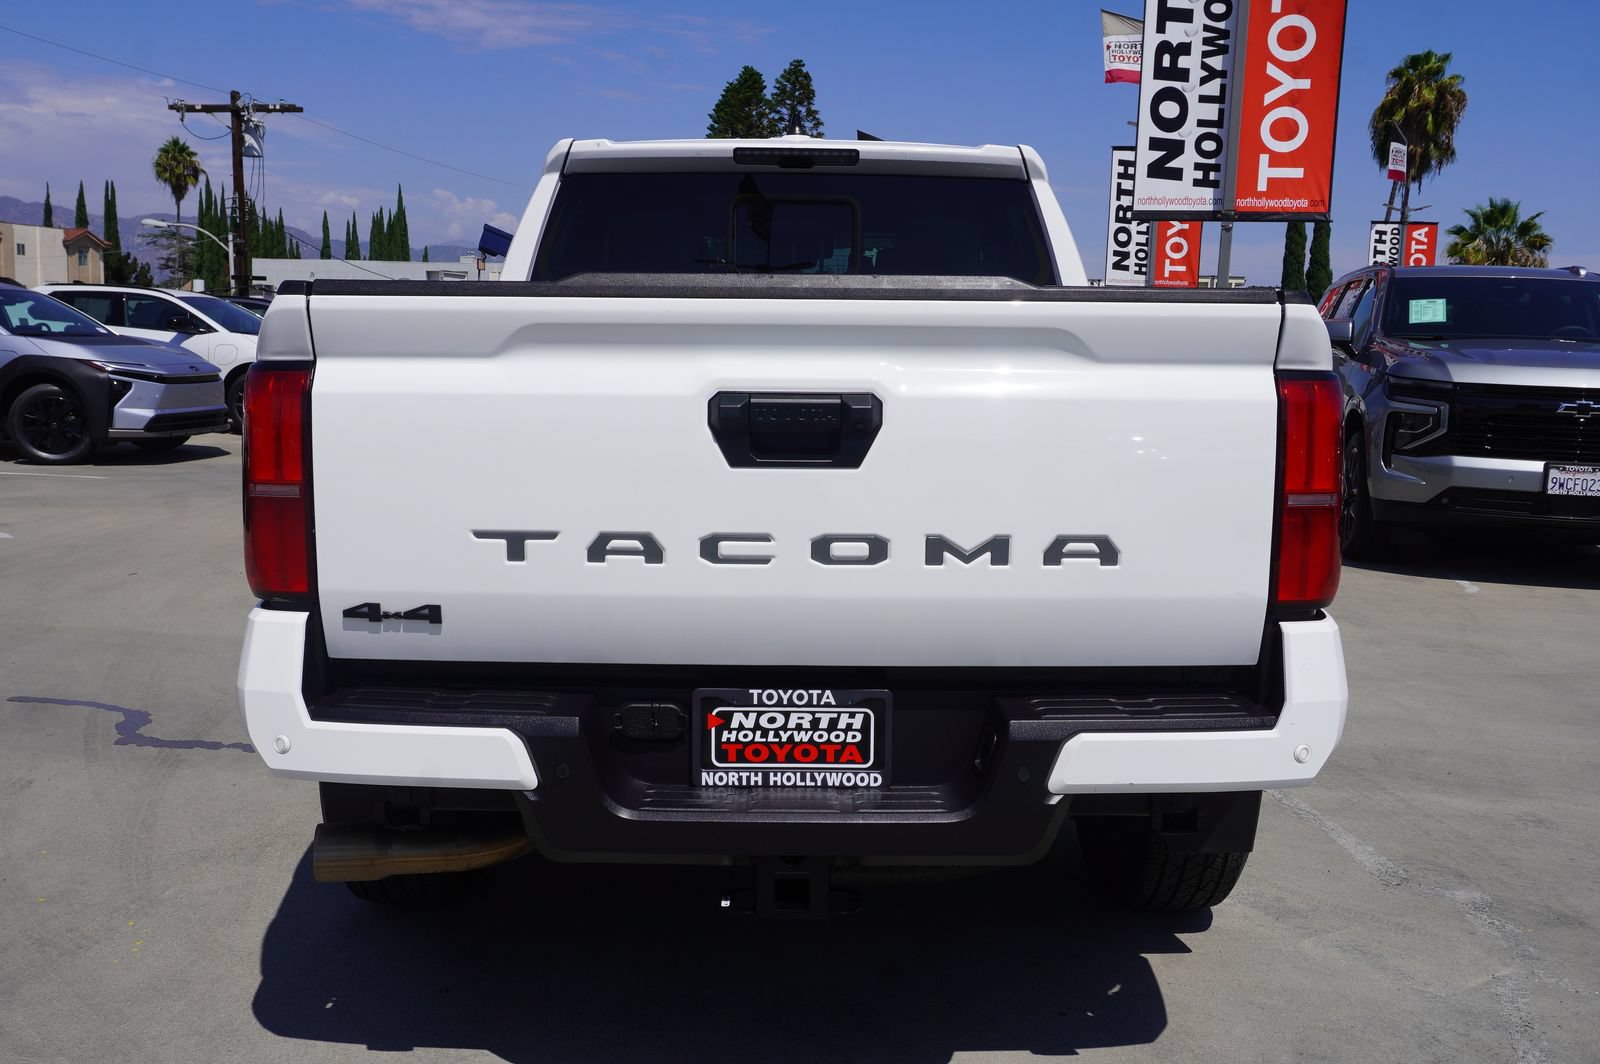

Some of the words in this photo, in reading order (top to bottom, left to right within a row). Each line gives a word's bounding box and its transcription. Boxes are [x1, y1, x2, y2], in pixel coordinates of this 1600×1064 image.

[1112, 159, 1136, 272] NORTH
[471, 529, 1121, 568] TACOMA
[749, 689, 836, 705] TOYOTA
[730, 712, 864, 730] NORTH
[721, 730, 862, 743] HOLLYWOOD
[721, 743, 864, 763] TOYOTA
[701, 772, 763, 786] NORTH
[769, 772, 882, 787] HOLLYWOOD
